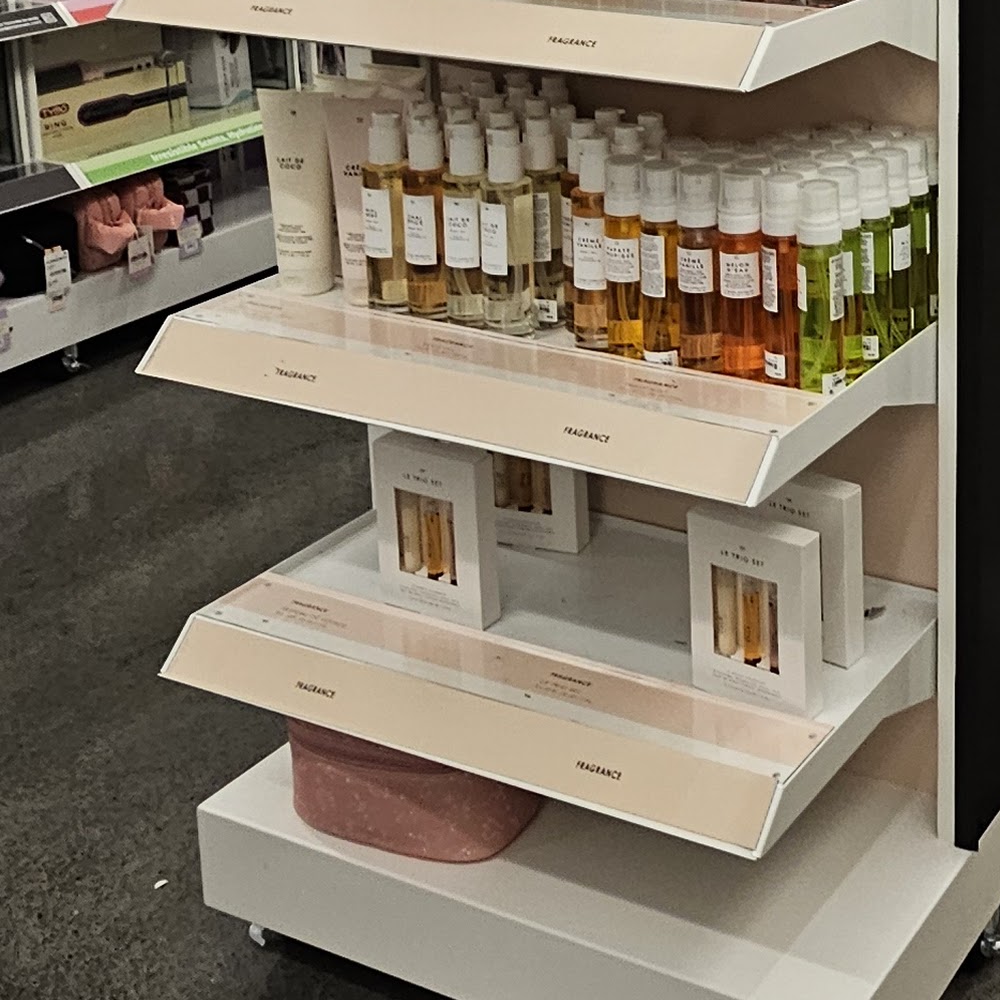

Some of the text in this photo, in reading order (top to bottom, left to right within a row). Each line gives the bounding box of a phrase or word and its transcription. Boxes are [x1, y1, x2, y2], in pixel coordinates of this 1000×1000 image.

[548, 35, 597, 48] FRAGRANCE
[274, 366, 318, 382] FRAGRANCE
[563, 425, 611, 444] FRAGRANCE
[732, 552, 749, 563] TRIO
[295, 681, 336, 700] FRAGRANCE
[575, 759, 624, 782] FRAGRANCE
